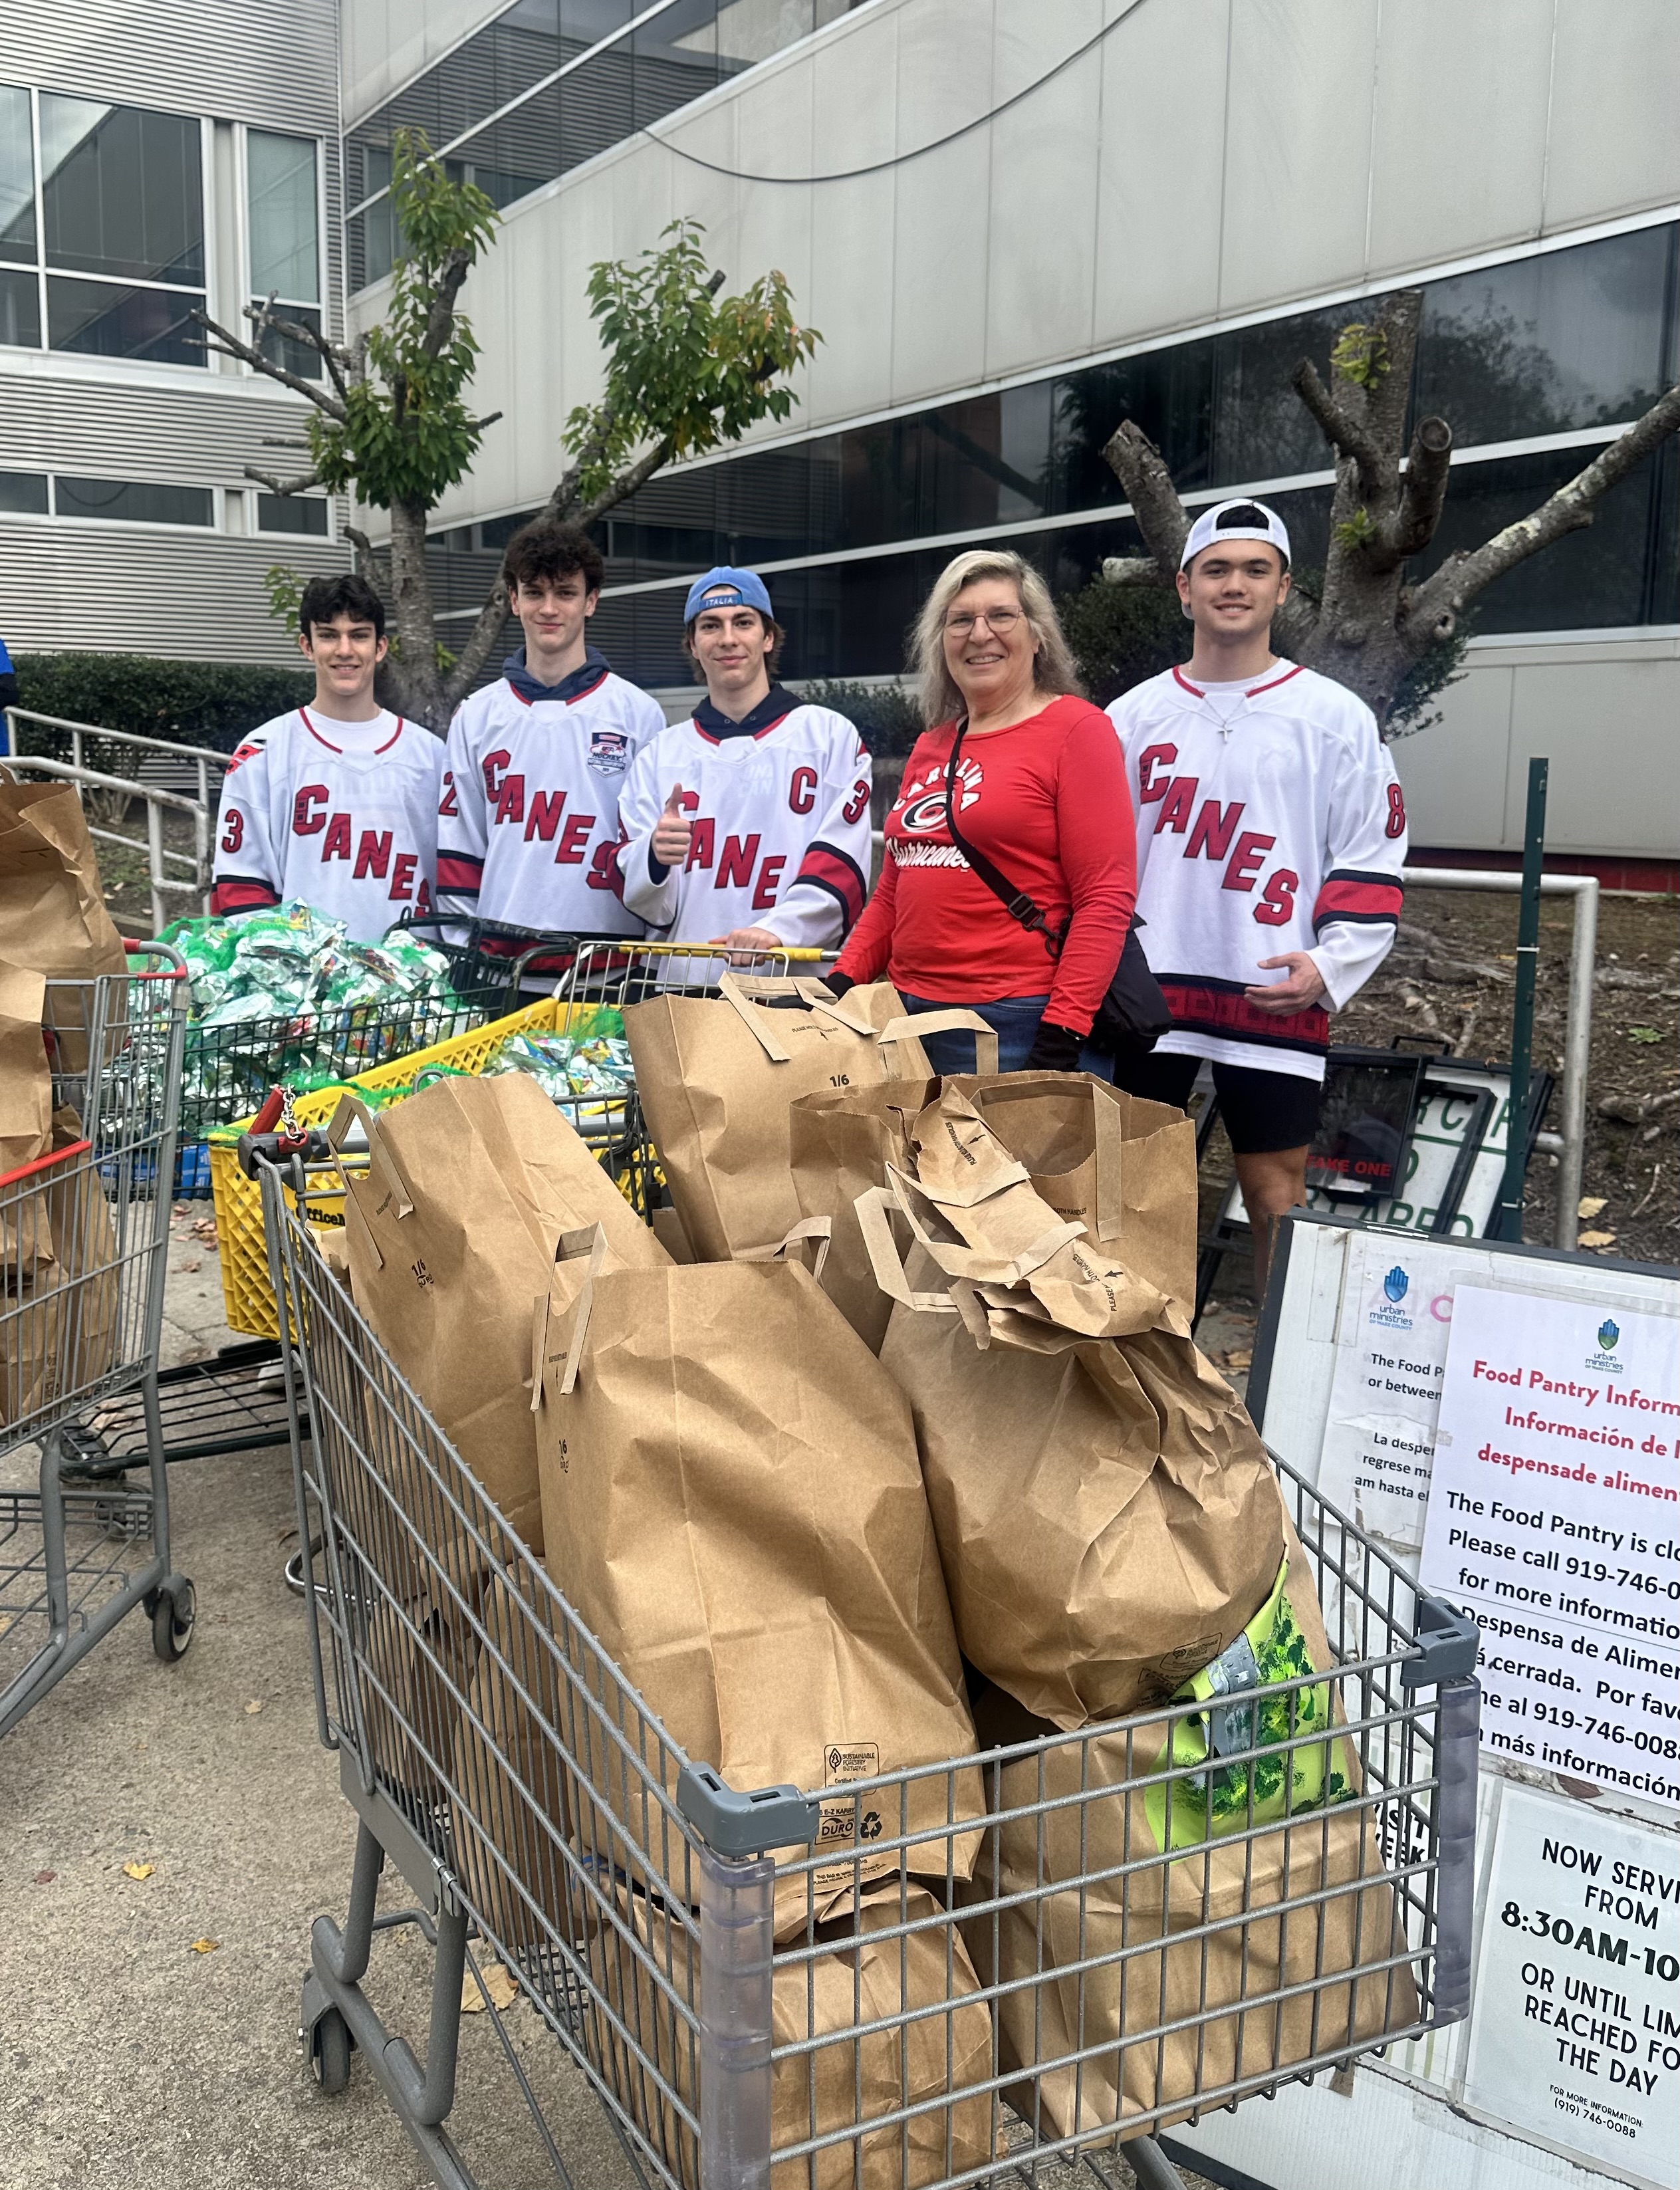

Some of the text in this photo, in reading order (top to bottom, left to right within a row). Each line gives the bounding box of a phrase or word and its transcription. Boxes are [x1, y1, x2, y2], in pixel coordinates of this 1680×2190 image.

[705, 597, 733, 607] ITALIA
[439, 771, 459, 817] 2
[788, 766, 818, 815] C
[842, 779, 870, 825] 3
[1385, 783, 1405, 840] 8
[221, 810, 244, 854] 3
[482, 749, 614, 890] CANES
[1139, 742, 1300, 927] CANES
[293, 785, 433, 918] CANES
[886, 835, 971, 868] Hurricane
[830, 1074, 850, 1087] 1/6
[1307, 1155, 1350, 1172] TAKE
[1354, 1160, 1392, 1177] ONE
[412, 1259, 426, 1276] 1/6
[1106, 1288, 1118, 1312] PLEASE
[1370, 1312, 1413, 1326] ministries
[1380, 1304, 1405, 1315] urban
[1371, 1354, 1394, 1368] The
[1398, 1360, 1431, 1376] Food
[1585, 1358, 1623, 1370] ministries
[1594, 1351, 1617, 1362] urban
[1368, 1378, 1442, 1400] or between
[1473, 1360, 1680, 1416] Food Pantry Inform
[1374, 1432, 1387, 1445] La
[1505, 1406, 1633, 1449] Información
[1641, 1434, 1667, 1456] de
[1363, 1455, 1411, 1474] regrese
[1477, 1443, 1680, 1502] despensade alimen
[1354, 1476, 1429, 1502] am hasta el
[1447, 1491, 1484, 1515] The
[1491, 1501, 1544, 1529] Food
[1550, 1515, 1624, 1551] Pantry
[1631, 1532, 1647, 1553] is
[1449, 1528, 1680, 1600] Please call 919-746-0
[1459, 1568, 1680, 1640] for more informatio
[1462, 1606, 1564, 1649] Despensa
[1570, 1636, 1598, 1658] de
[1493, 1656, 1582, 1693] cerrada.
[1596, 1680, 1635, 1707] Por
[1641, 1693, 1680, 1719] fav
[1508, 1697, 1528, 1716] al
[1533, 1703, 1680, 1760] 919-746-008
[1491, 1735, 1680, 1801] más información
[821, 1822, 854, 1836] DURO
[1542, 1838, 1602, 1876] NOW
[1584, 1884, 1658, 1930] FROM
[1501, 1901, 1680, 1982] 8:30AM-10
[1521, 1963, 1554, 1993] OR
[1564, 1977, 1631, 2021] UNTIL
[1524, 1994, 1680, 2070] REACHED FO
[1556, 2037, 1659, 2096] THE DAY
[1550, 2084, 1564, 2097] FOR
[1566, 2091, 1588, 2106] MORE
[1554, 2097, 1636, 2138] (919) 746-0088
